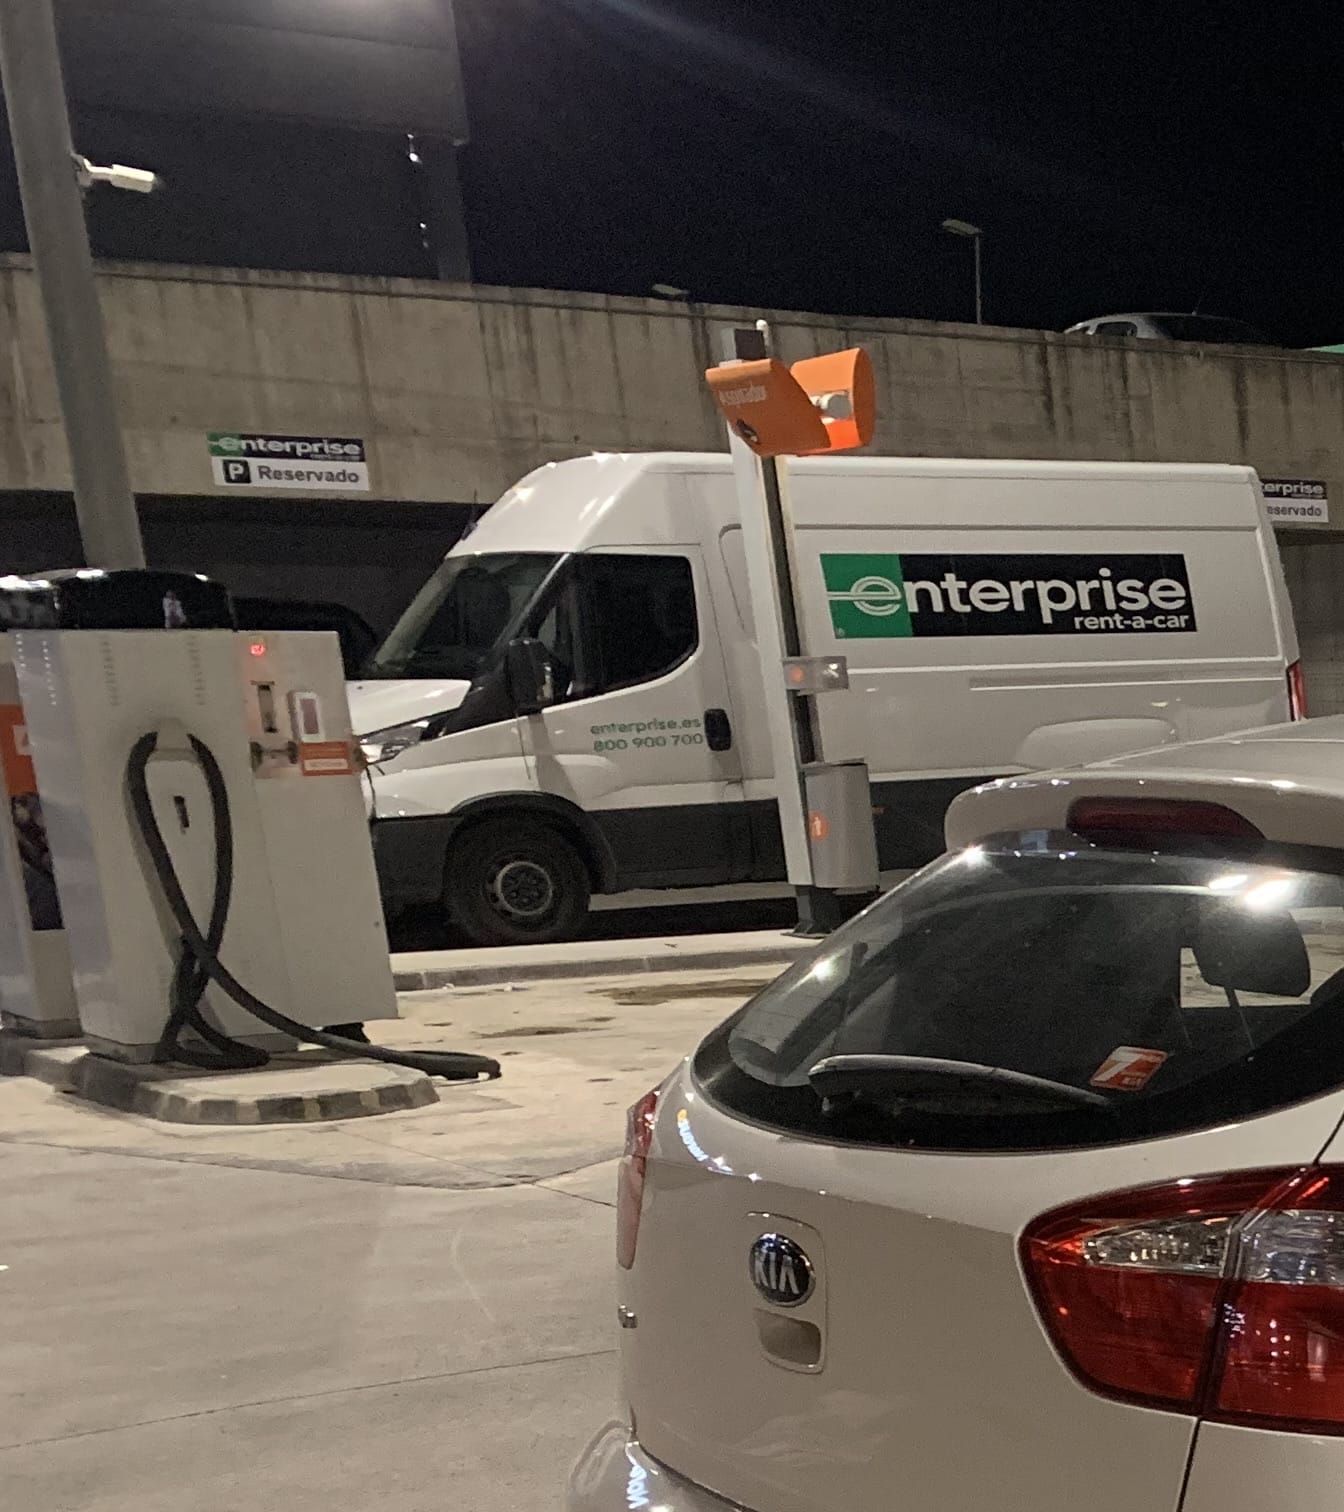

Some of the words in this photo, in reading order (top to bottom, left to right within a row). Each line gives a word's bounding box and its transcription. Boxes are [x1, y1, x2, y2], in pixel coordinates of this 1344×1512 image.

[208, 437, 361, 456] enterprise
[258, 465, 359, 483] Reservado
[1267, 505, 1322, 516] eservado
[828, 567, 1187, 624] enterprise
[1074, 613, 1190, 630] rent-a-car
[590, 718, 702, 735] enterprise.es
[632, 736, 667, 748] 900
[670, 733, 704, 746] 700
[754, 1245, 800, 1295] KIA
